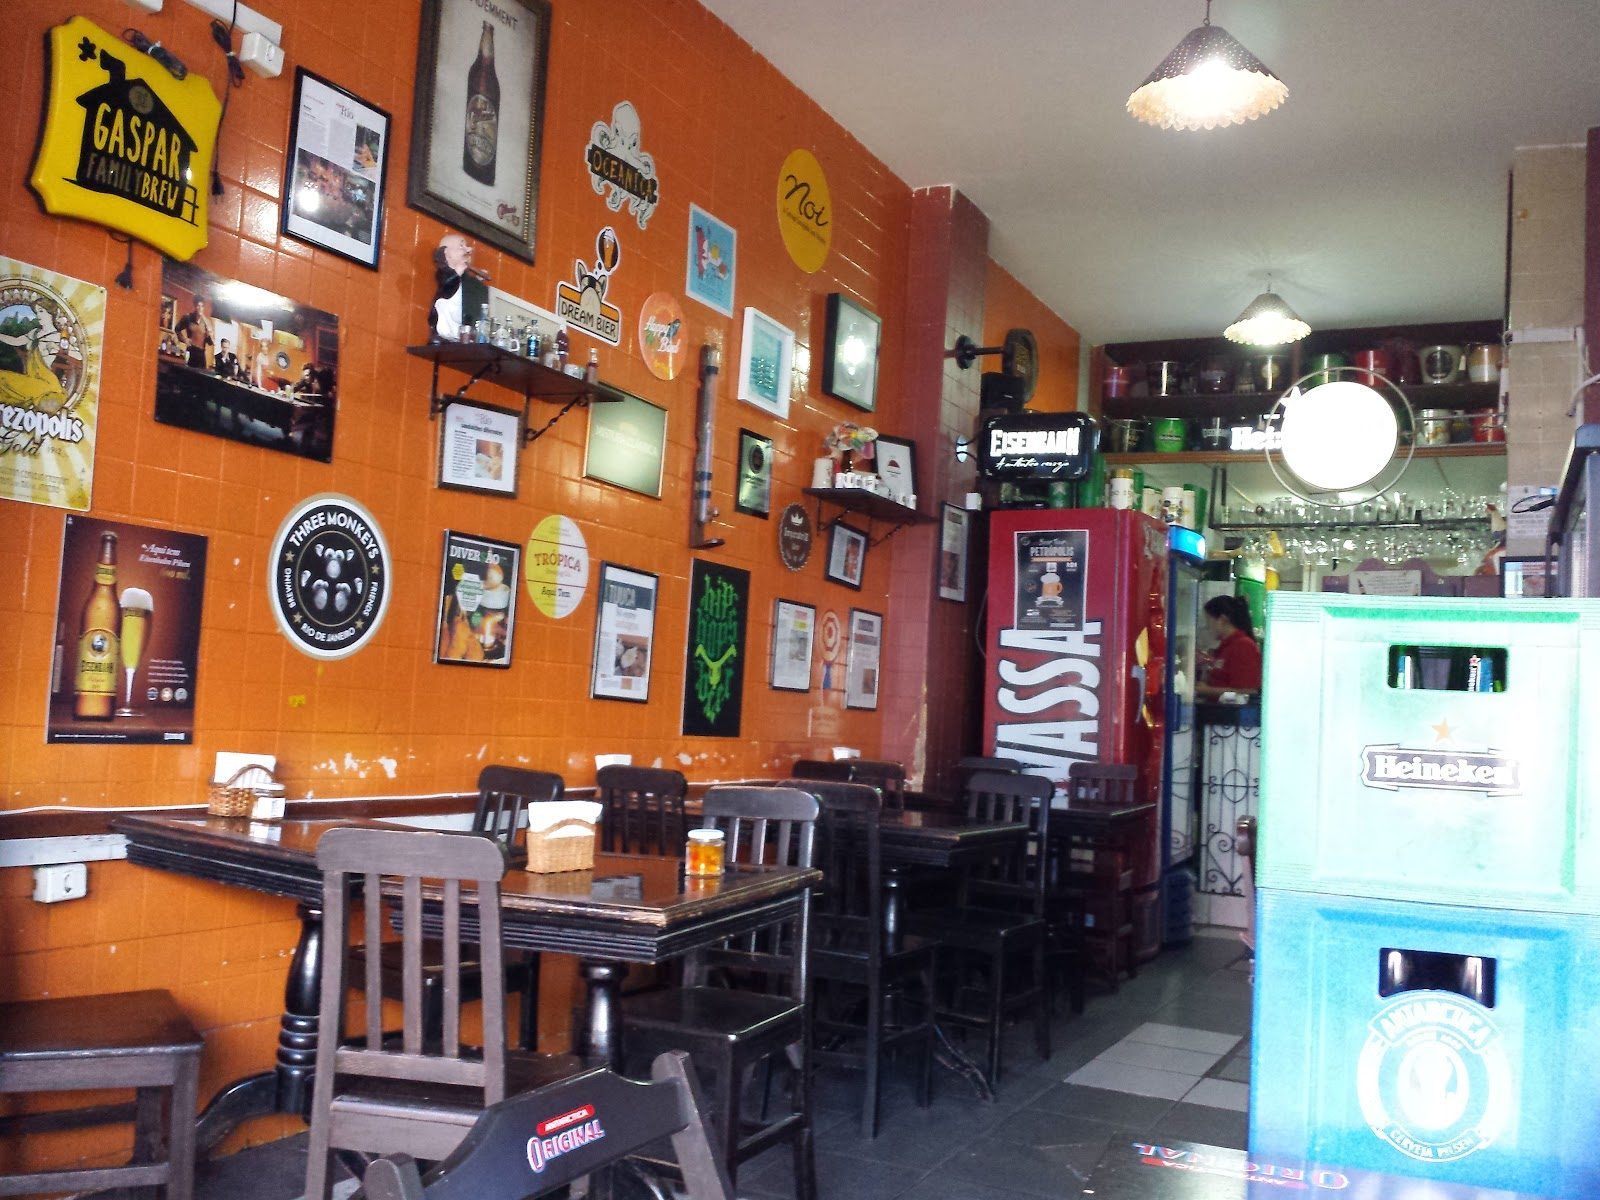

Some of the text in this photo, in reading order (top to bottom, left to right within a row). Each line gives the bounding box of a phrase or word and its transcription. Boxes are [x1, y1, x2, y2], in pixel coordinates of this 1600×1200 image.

[93, 102, 182, 182] GASPAR
[561, 300, 617, 338] DREAM BIER
[990, 427, 1081, 457] EISENBAHN
[288, 511, 380, 559] THREE MONKEYS
[1030, 544, 1075, 558] PETRÓPOLIS
[534, 549, 582, 573] TRÓPICA
[363, 581, 379, 617] FRIENDS
[300, 621, 357, 642] RIO DE JANEIRO
[996, 621, 1101, 784] VASSA
[1373, 754, 1515, 785] Heineken
[526, 1119, 606, 1174] ORIGINAL
